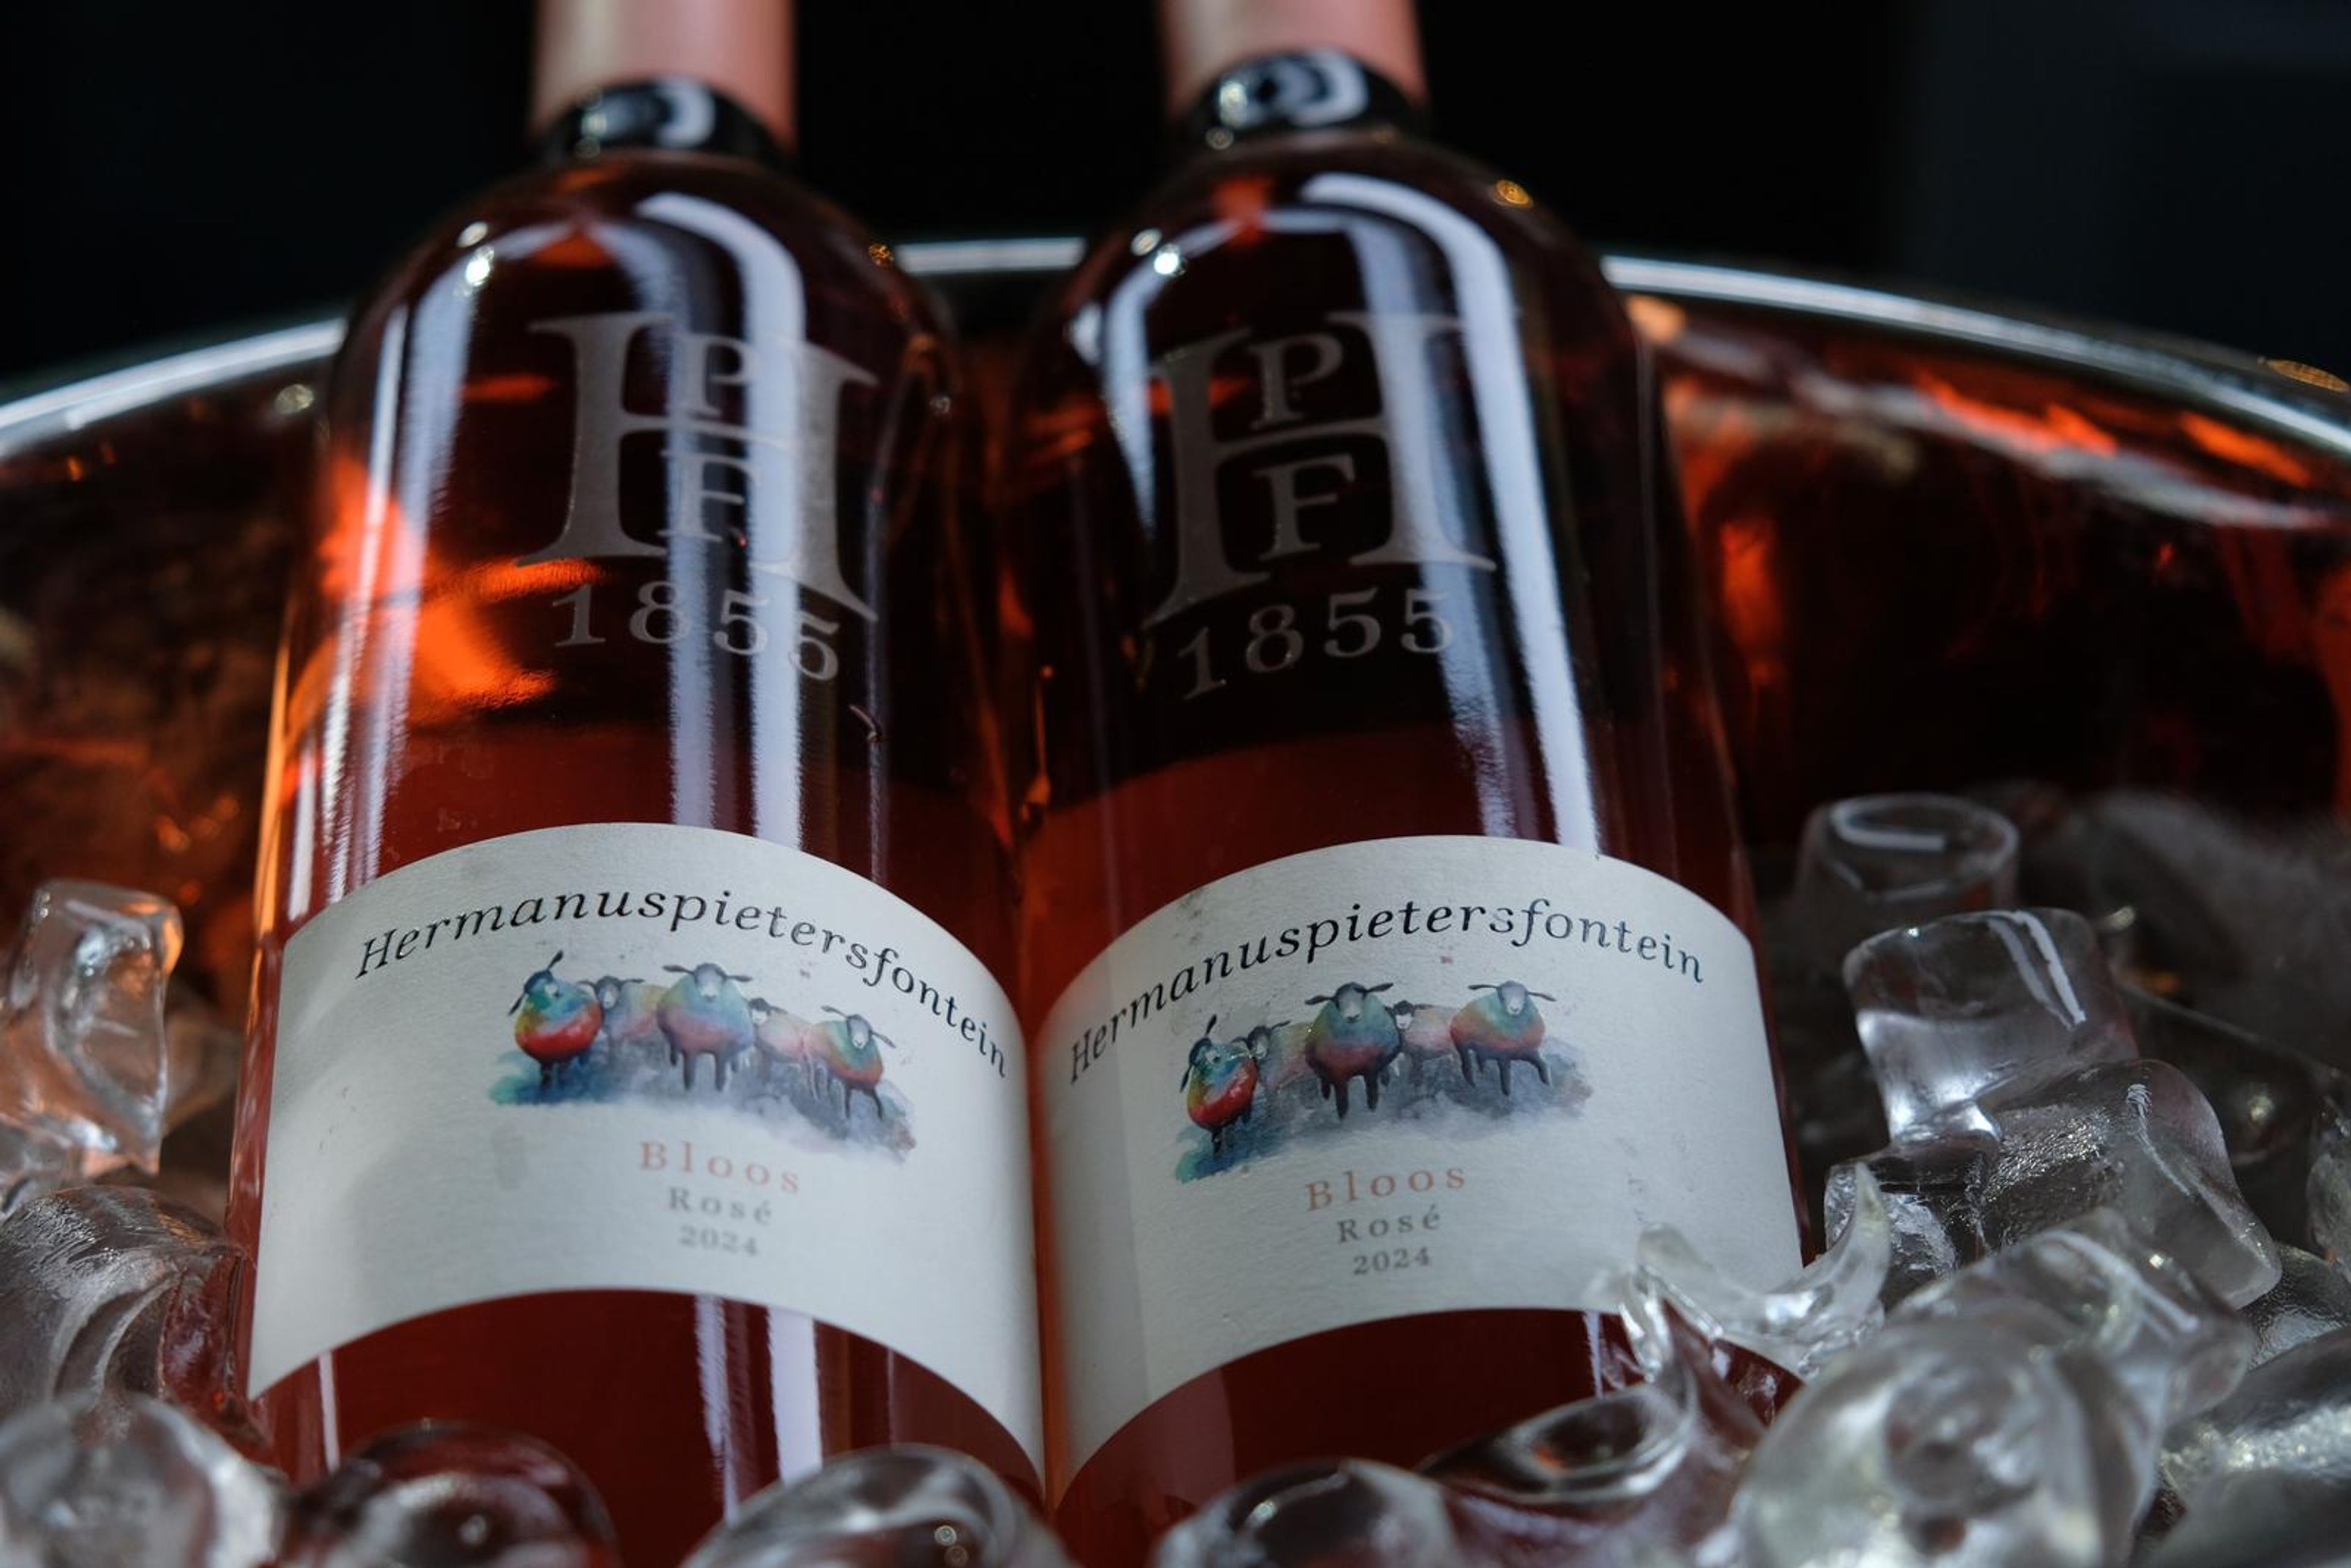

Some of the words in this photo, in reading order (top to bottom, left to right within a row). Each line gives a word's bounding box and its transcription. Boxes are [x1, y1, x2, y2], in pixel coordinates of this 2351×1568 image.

[553, 579, 840, 681] 1855
[1177, 586, 1453, 700] 1855
[354, 890, 1007, 1079] Hermanuspietersfontein
[1070, 897, 1703, 1086] Hermanuspietersfontein
[640, 1140, 799, 1195] Bloos
[1305, 1167, 1465, 1211] Bloos
[669, 1187, 772, 1226] Rosé
[1337, 1204, 1441, 1243] Rosé
[679, 1225, 758, 1255] 2024
[1353, 1247, 1430, 1275] 2024
